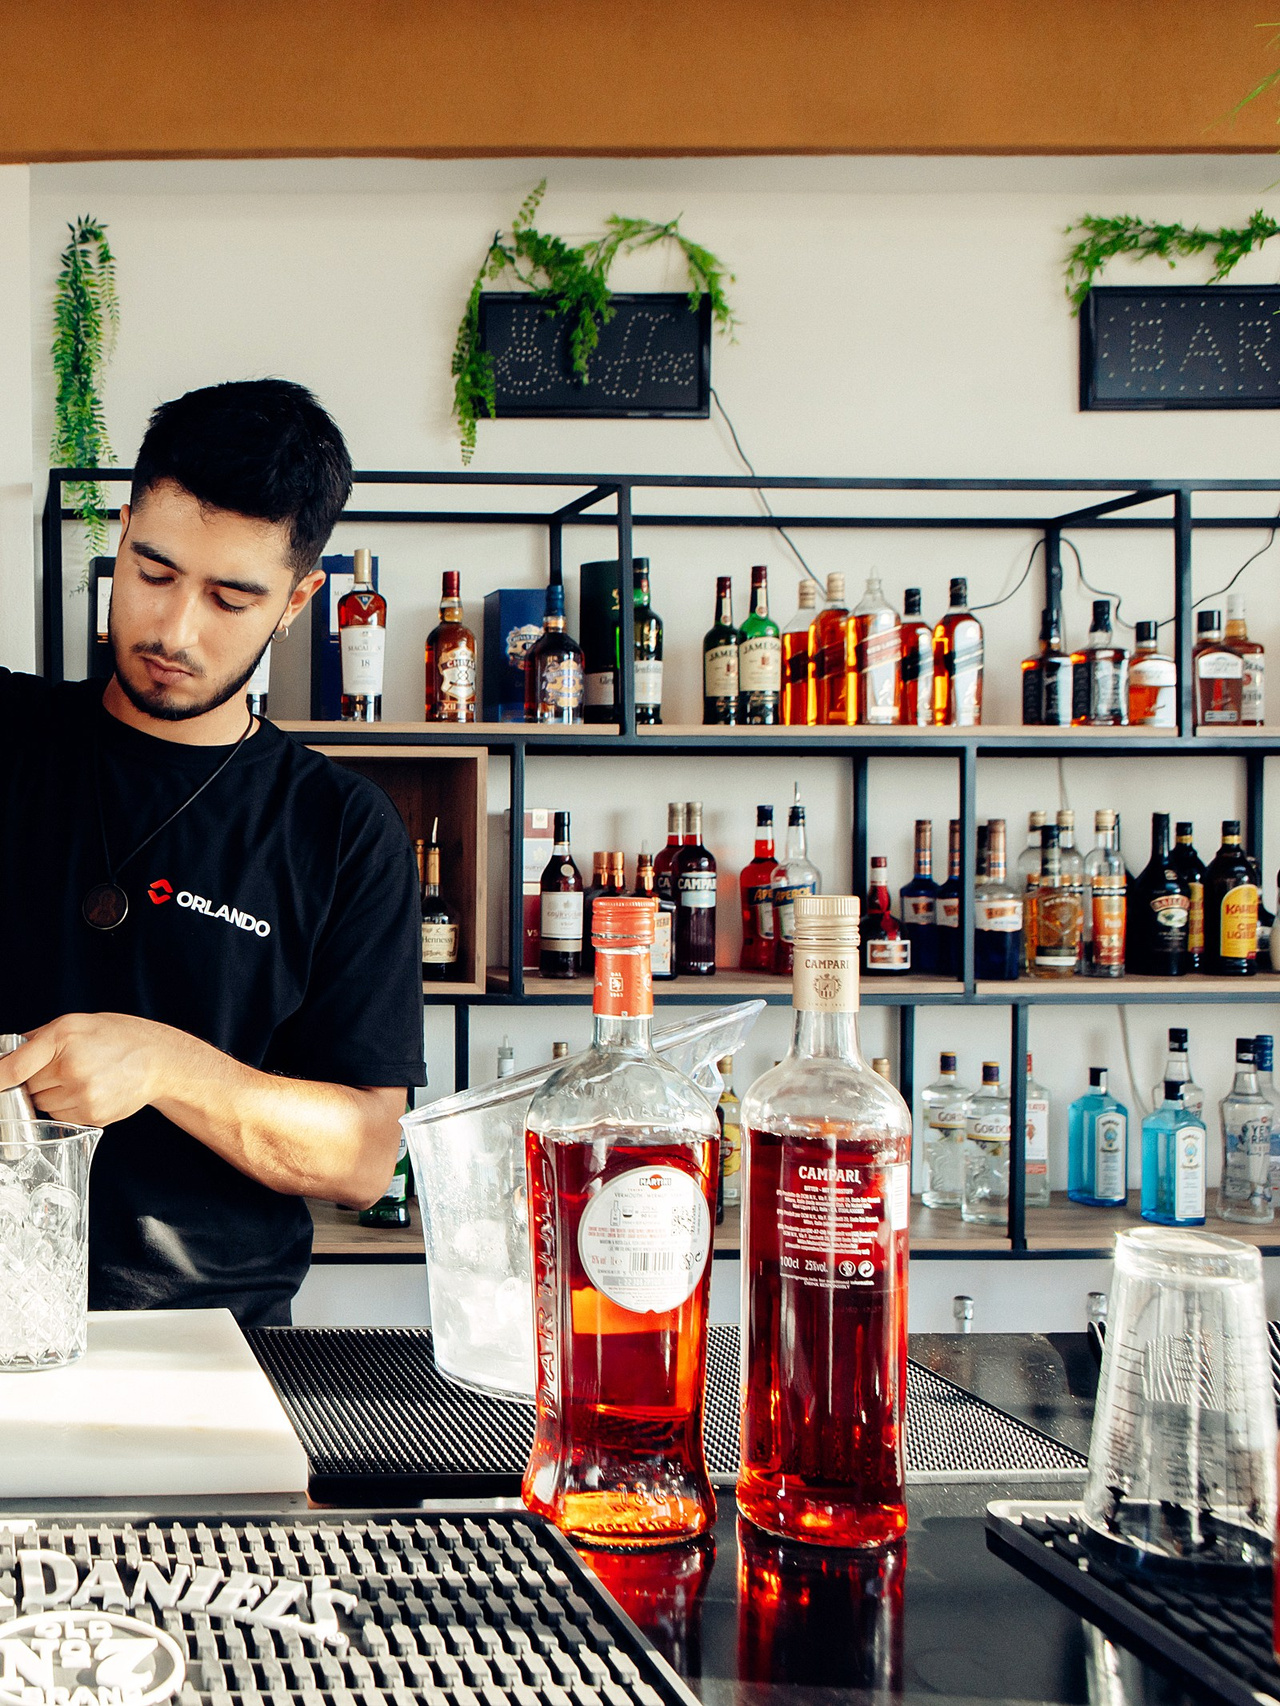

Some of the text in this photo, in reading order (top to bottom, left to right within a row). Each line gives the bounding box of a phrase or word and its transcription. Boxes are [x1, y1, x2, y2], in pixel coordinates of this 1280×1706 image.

[1130, 318, 1271, 373] BAR
[360, 658, 370, 667] 18
[176, 891, 271, 937] ORLANDO
[804, 959, 849, 970] CAMPARI
[639, 1177, 672, 1186] MARTINI
[798, 1165, 862, 1184] CAMPARI
[35, 1621, 113, 1640] OLD
